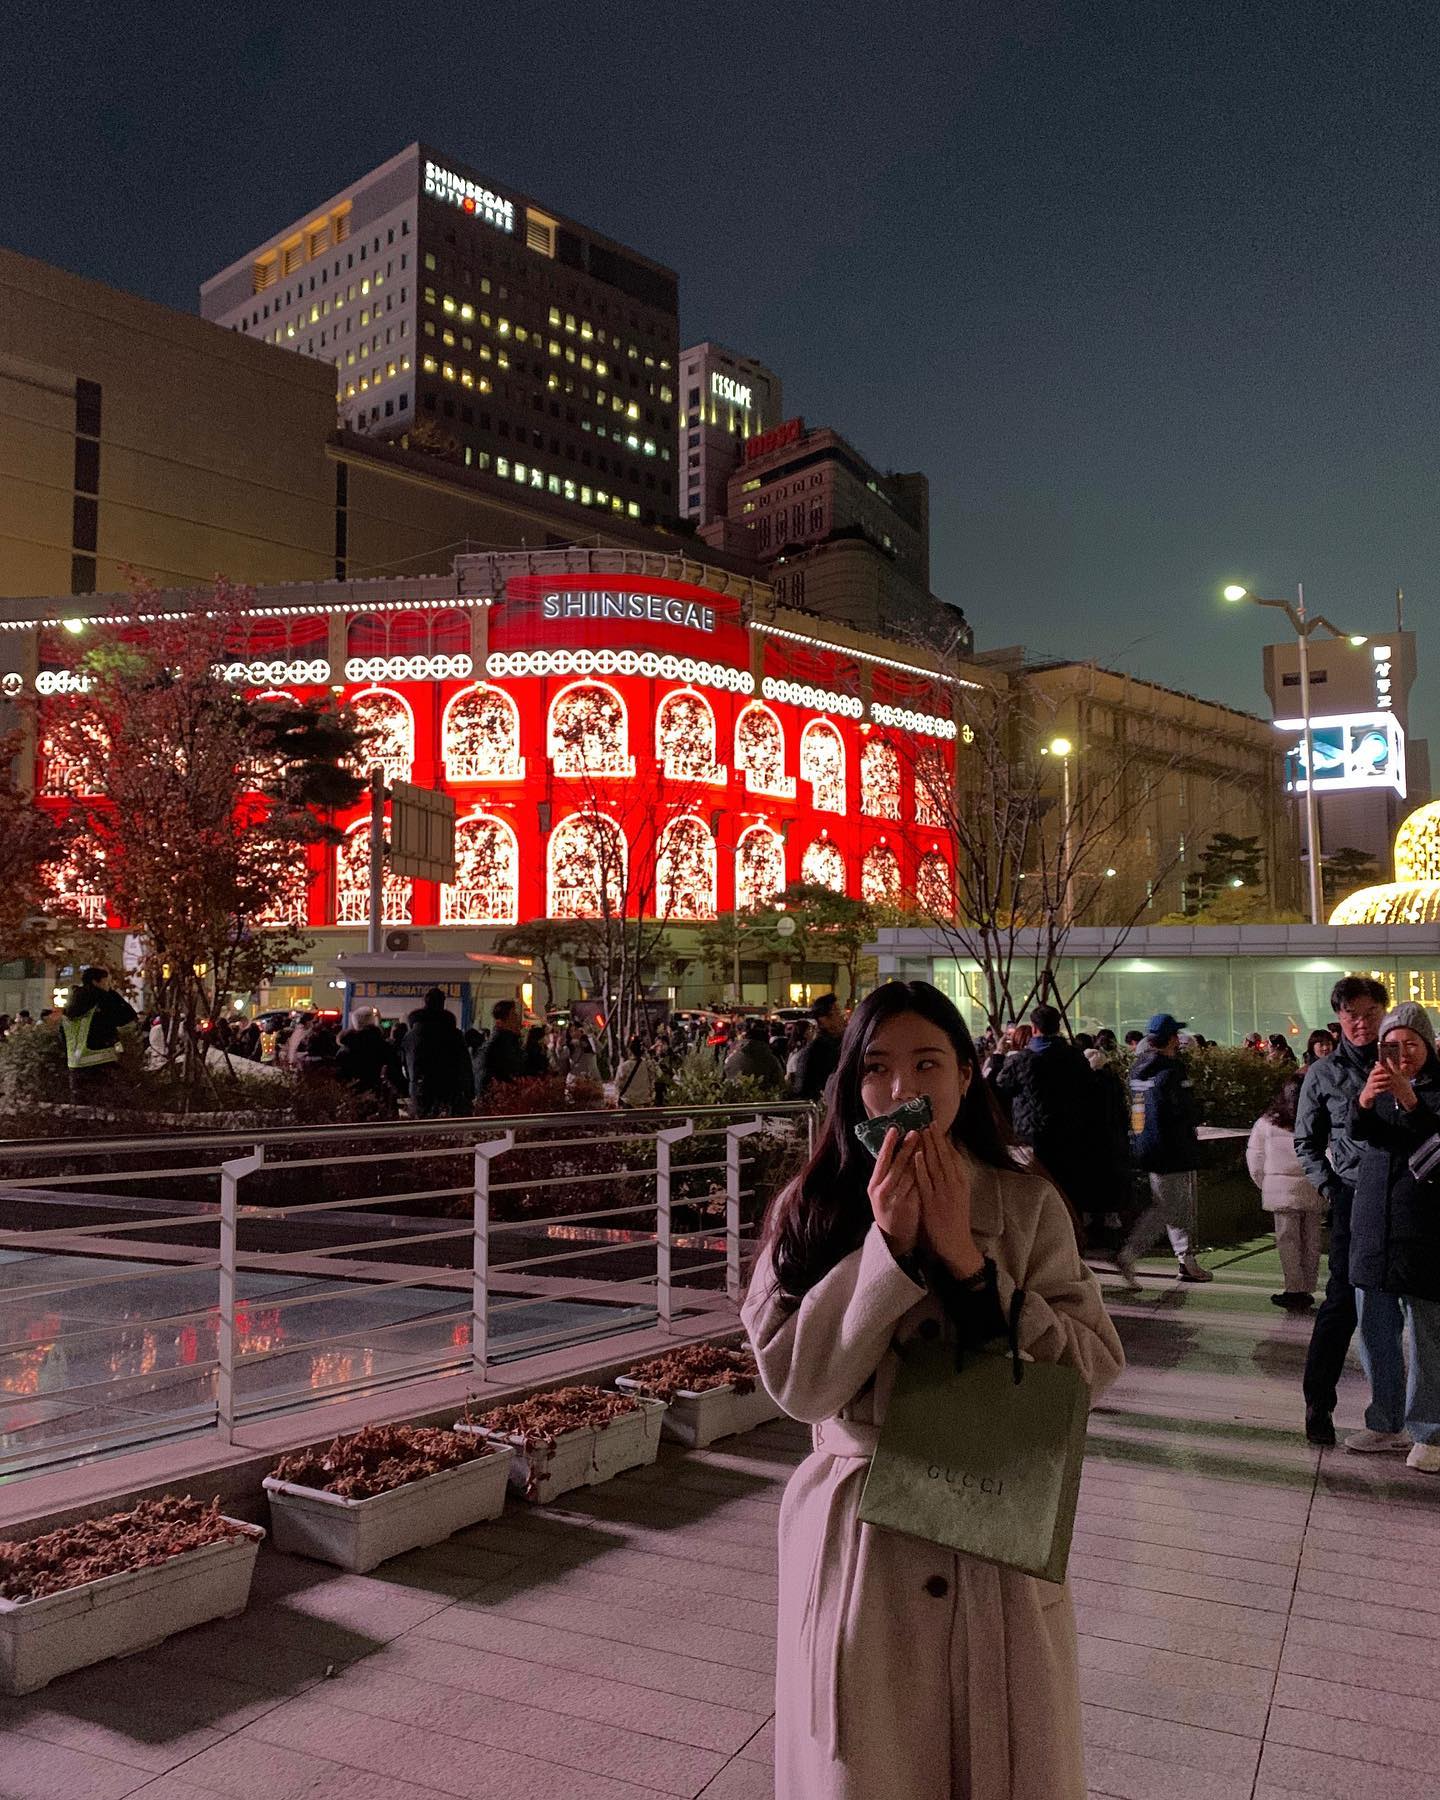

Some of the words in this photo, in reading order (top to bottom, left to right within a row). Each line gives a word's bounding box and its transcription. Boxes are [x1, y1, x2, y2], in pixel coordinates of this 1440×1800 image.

[425, 160, 514, 218] SHINSEGAE
[425, 178, 464, 208] DUTY
[475, 201, 514, 234] FREE
[543, 592, 715, 633] SHINSEGAE
[379, 984, 434, 995] INFORMATIO
[927, 1464, 1004, 1496] GUCCI
